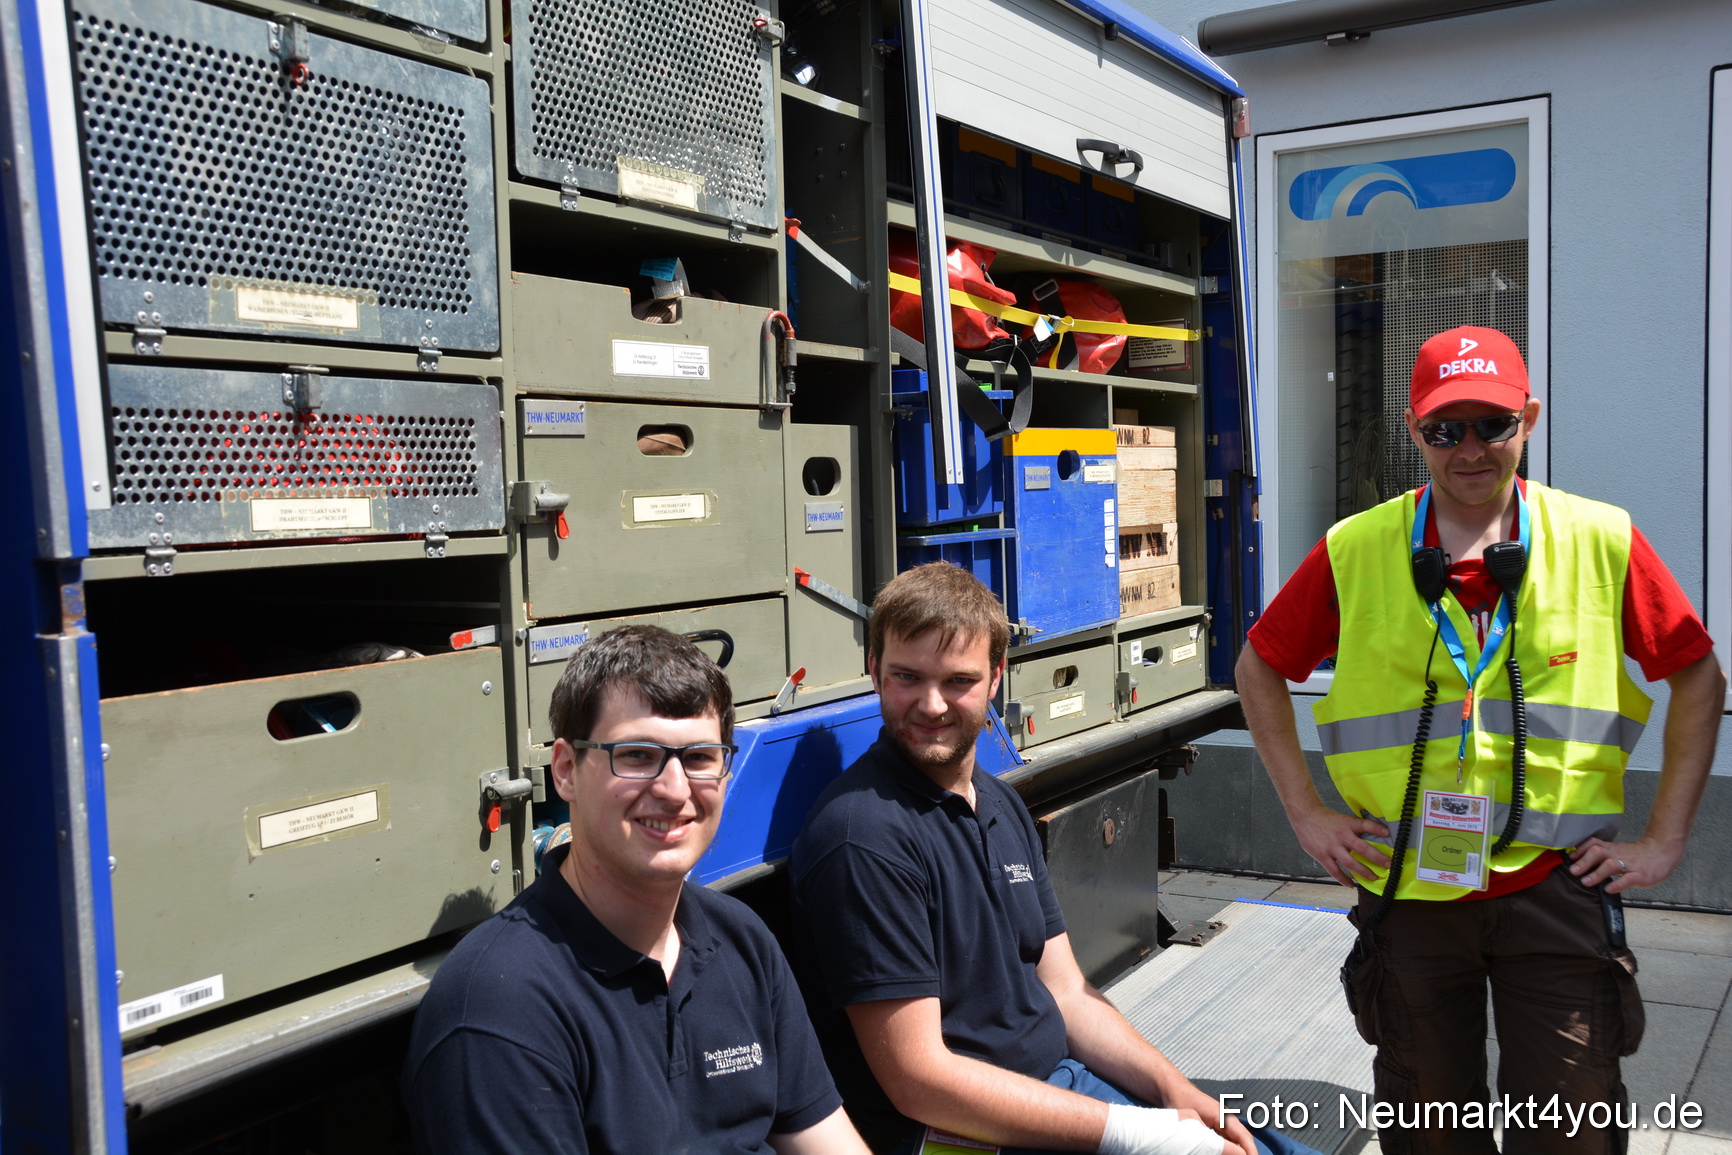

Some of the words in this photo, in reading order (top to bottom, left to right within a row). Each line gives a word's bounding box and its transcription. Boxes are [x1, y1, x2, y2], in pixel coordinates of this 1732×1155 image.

[1439, 358, 1498, 379] DEKRA
[526, 412, 584, 423] THW-NEUMARKT
[807, 512, 843, 522] THW-NEUMARKT
[531, 633, 588, 651] THW-NEUMARKT
[306, 811, 335, 822] NEUMARKT
[330, 814, 354, 824] ZUBEHÖR
[1442, 845, 1462, 854] Ordner
[704, 1045, 750, 1061] Technisches
[715, 1054, 752, 1069] Hilfswerk
